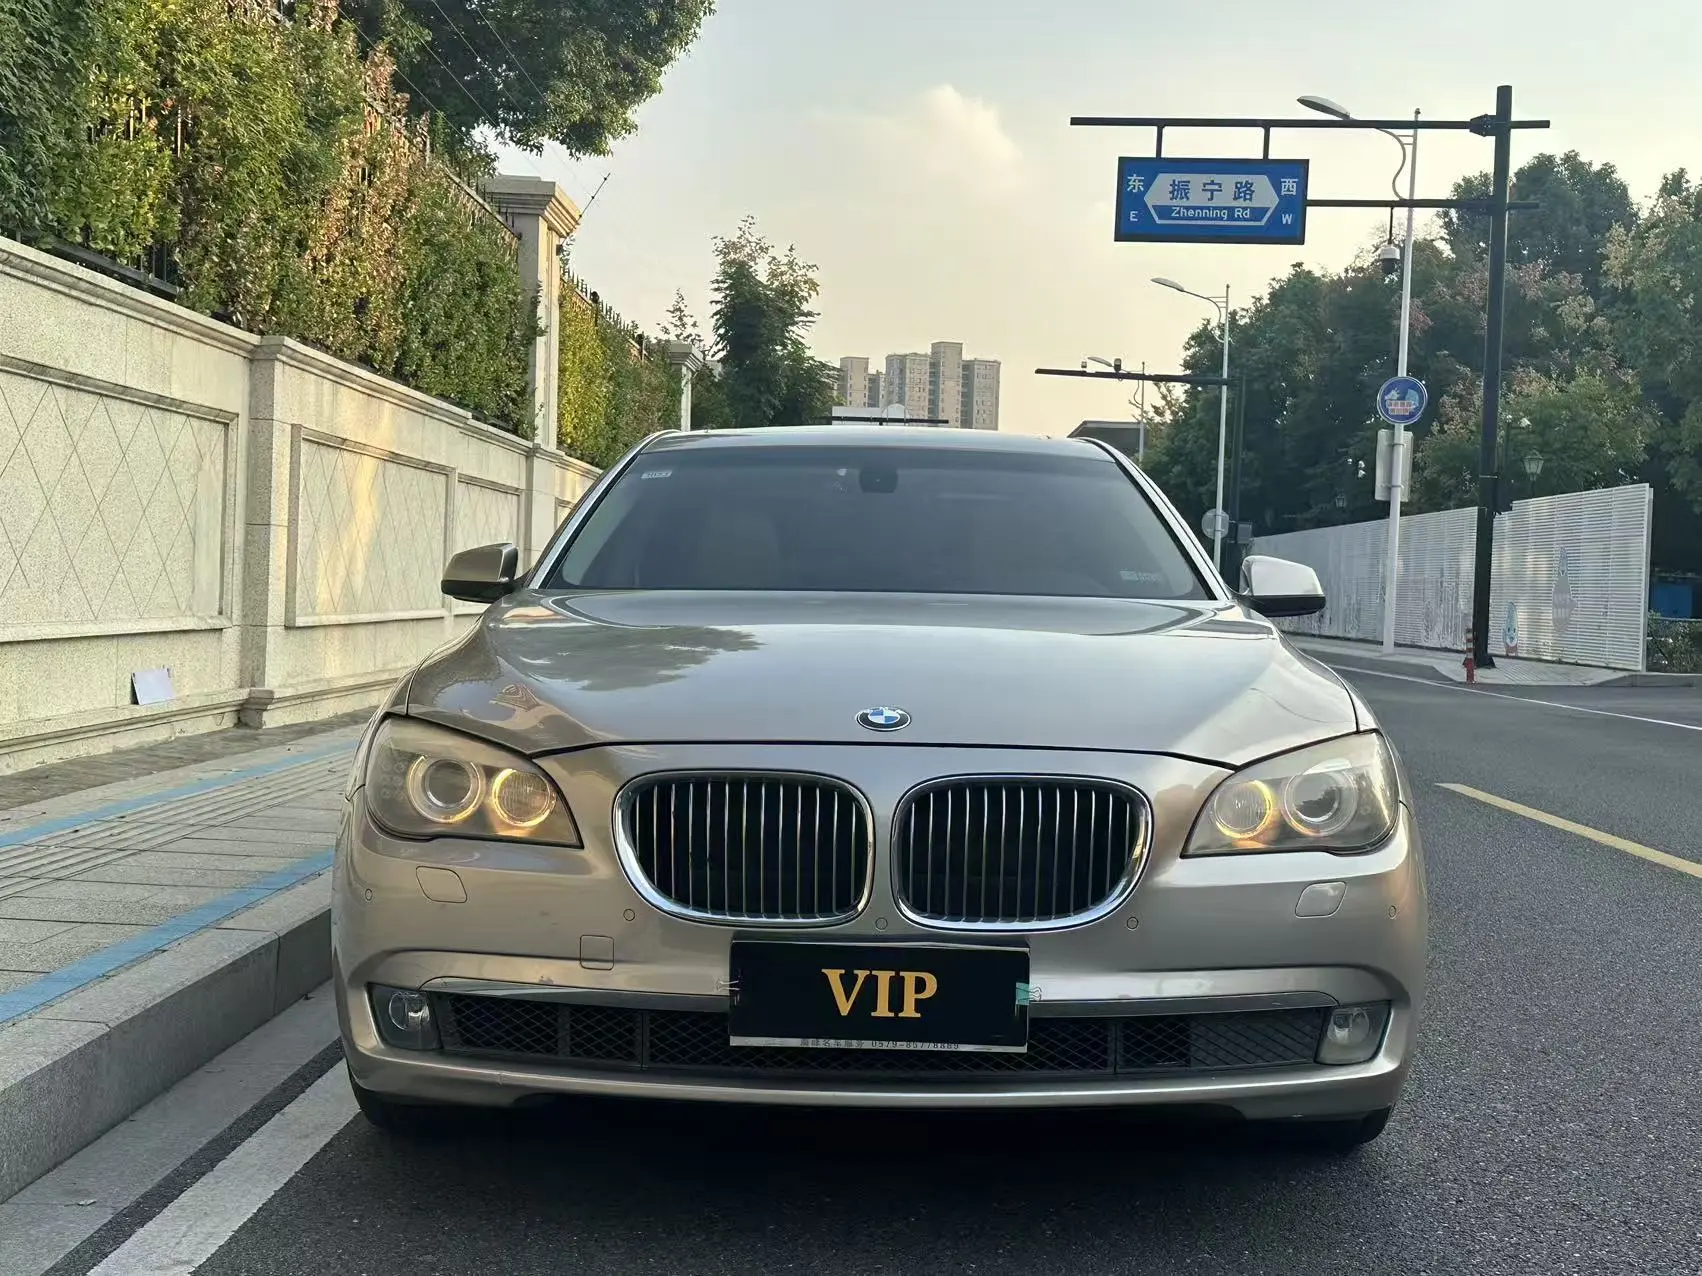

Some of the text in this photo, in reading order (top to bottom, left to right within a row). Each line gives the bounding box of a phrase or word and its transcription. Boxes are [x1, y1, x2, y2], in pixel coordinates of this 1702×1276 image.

[1127, 174, 1144, 192] 东
[1169, 179, 1255, 202] 振宁路
[1280, 178, 1298, 196] 西
[1129, 211, 1138, 221] E
[1171, 207, 1250, 220] Zhenning Rd
[1281, 213, 1293, 225] W
[821, 968, 938, 1018] VIP
